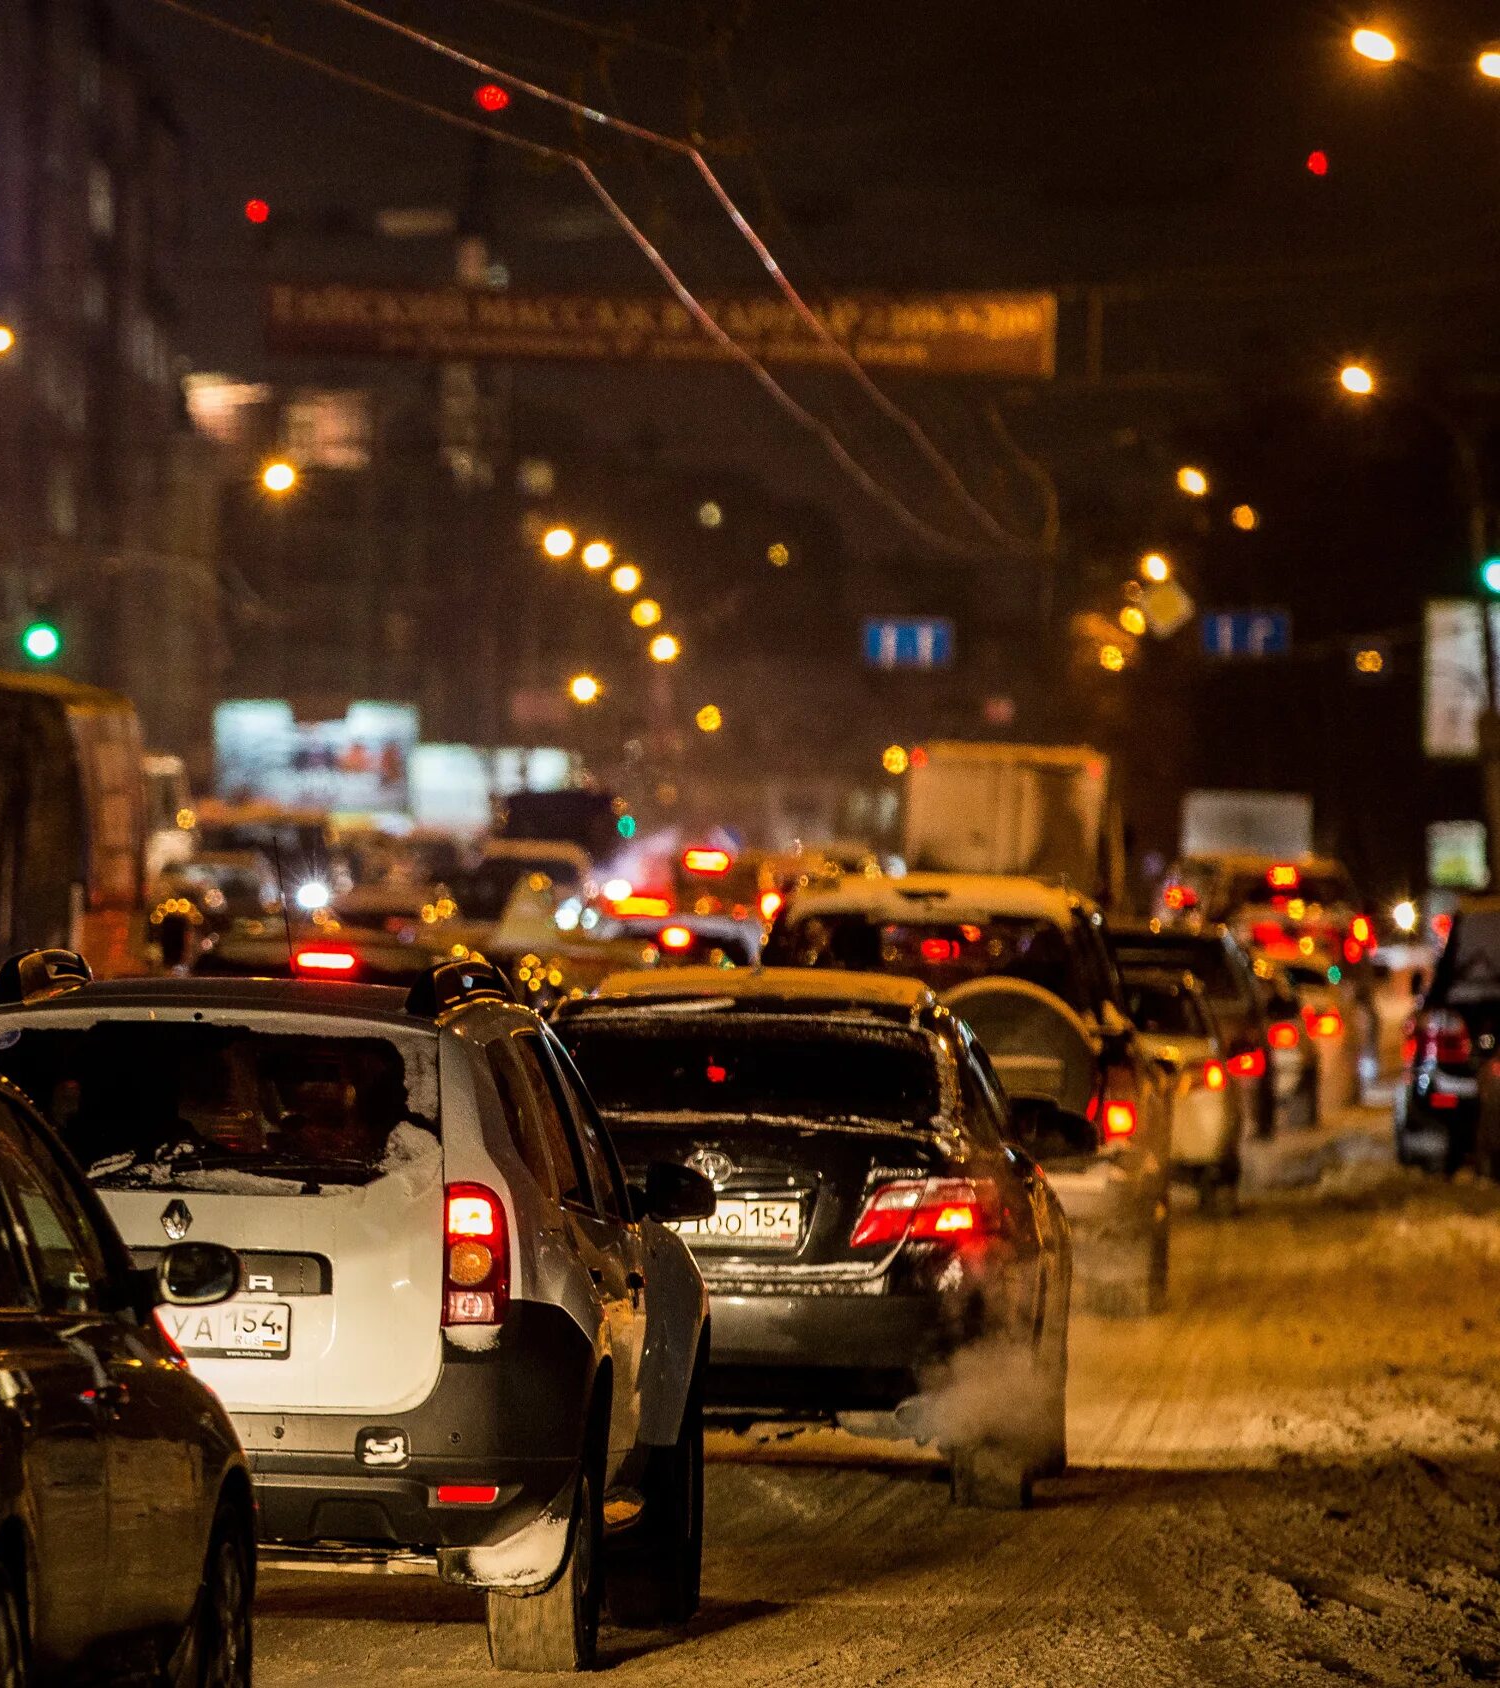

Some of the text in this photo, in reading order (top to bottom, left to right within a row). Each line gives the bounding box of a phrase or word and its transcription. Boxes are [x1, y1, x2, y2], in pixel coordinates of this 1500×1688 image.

[750, 1207, 791, 1228] 154
[224, 1308, 277, 1336] 154
[235, 1335, 261, 1346] RUS
